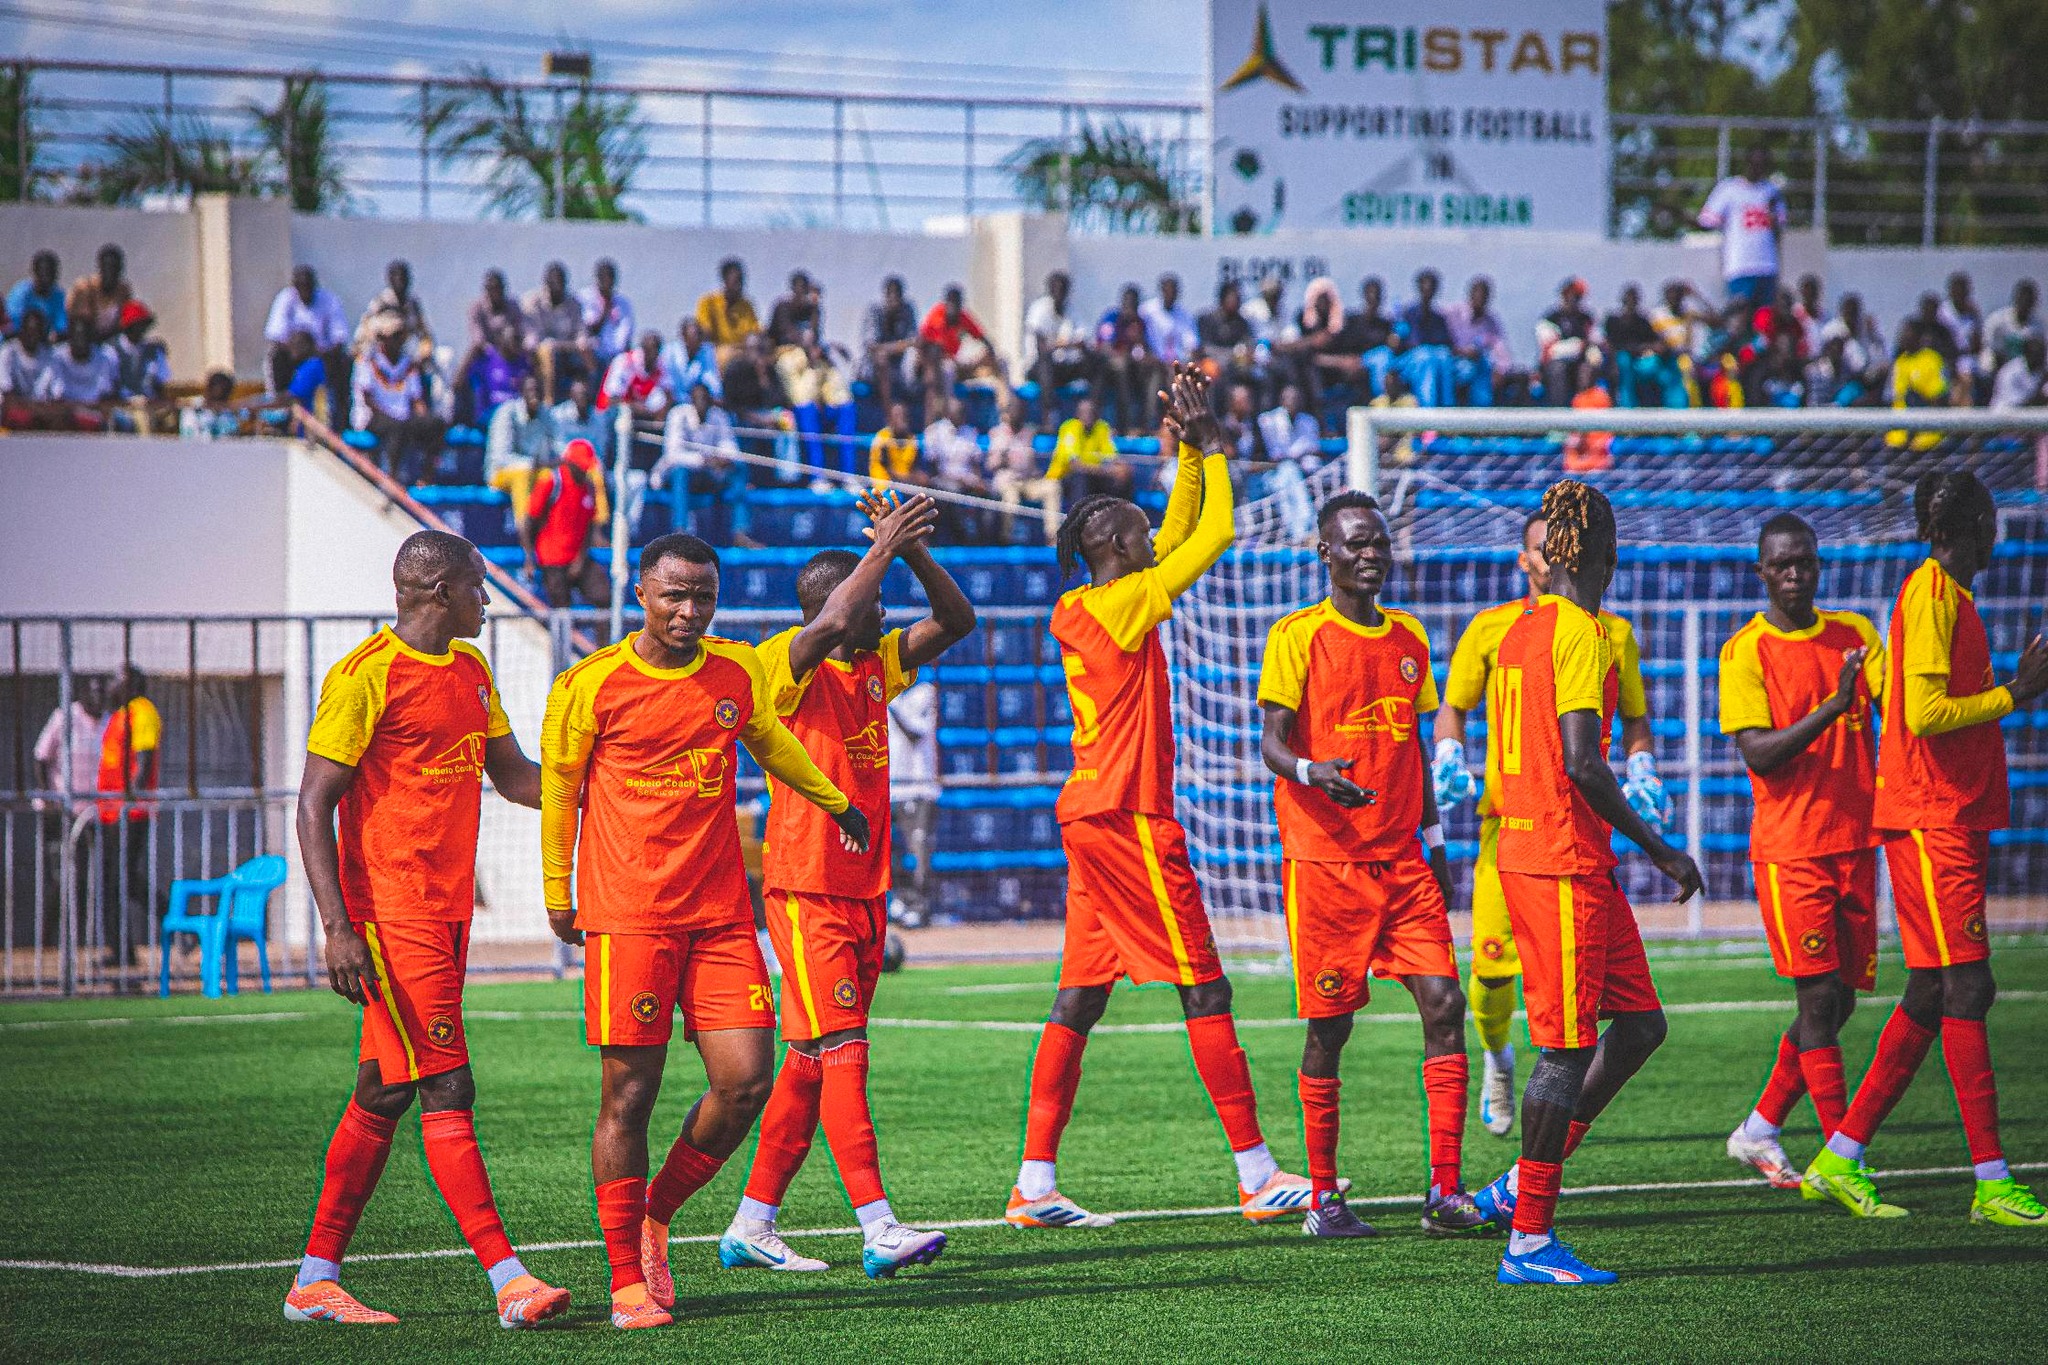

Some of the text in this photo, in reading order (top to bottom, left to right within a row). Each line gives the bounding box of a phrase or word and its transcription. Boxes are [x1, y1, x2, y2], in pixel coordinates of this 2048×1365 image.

[1308, 23, 1600, 74] TRISTAR
[1280, 103, 1594, 142] SUPPORTING FOOTBALL
[1342, 191, 1533, 226] SOUTH SUDAN
[664, 778, 696, 788] Coach
[747, 983, 774, 1012] 24
